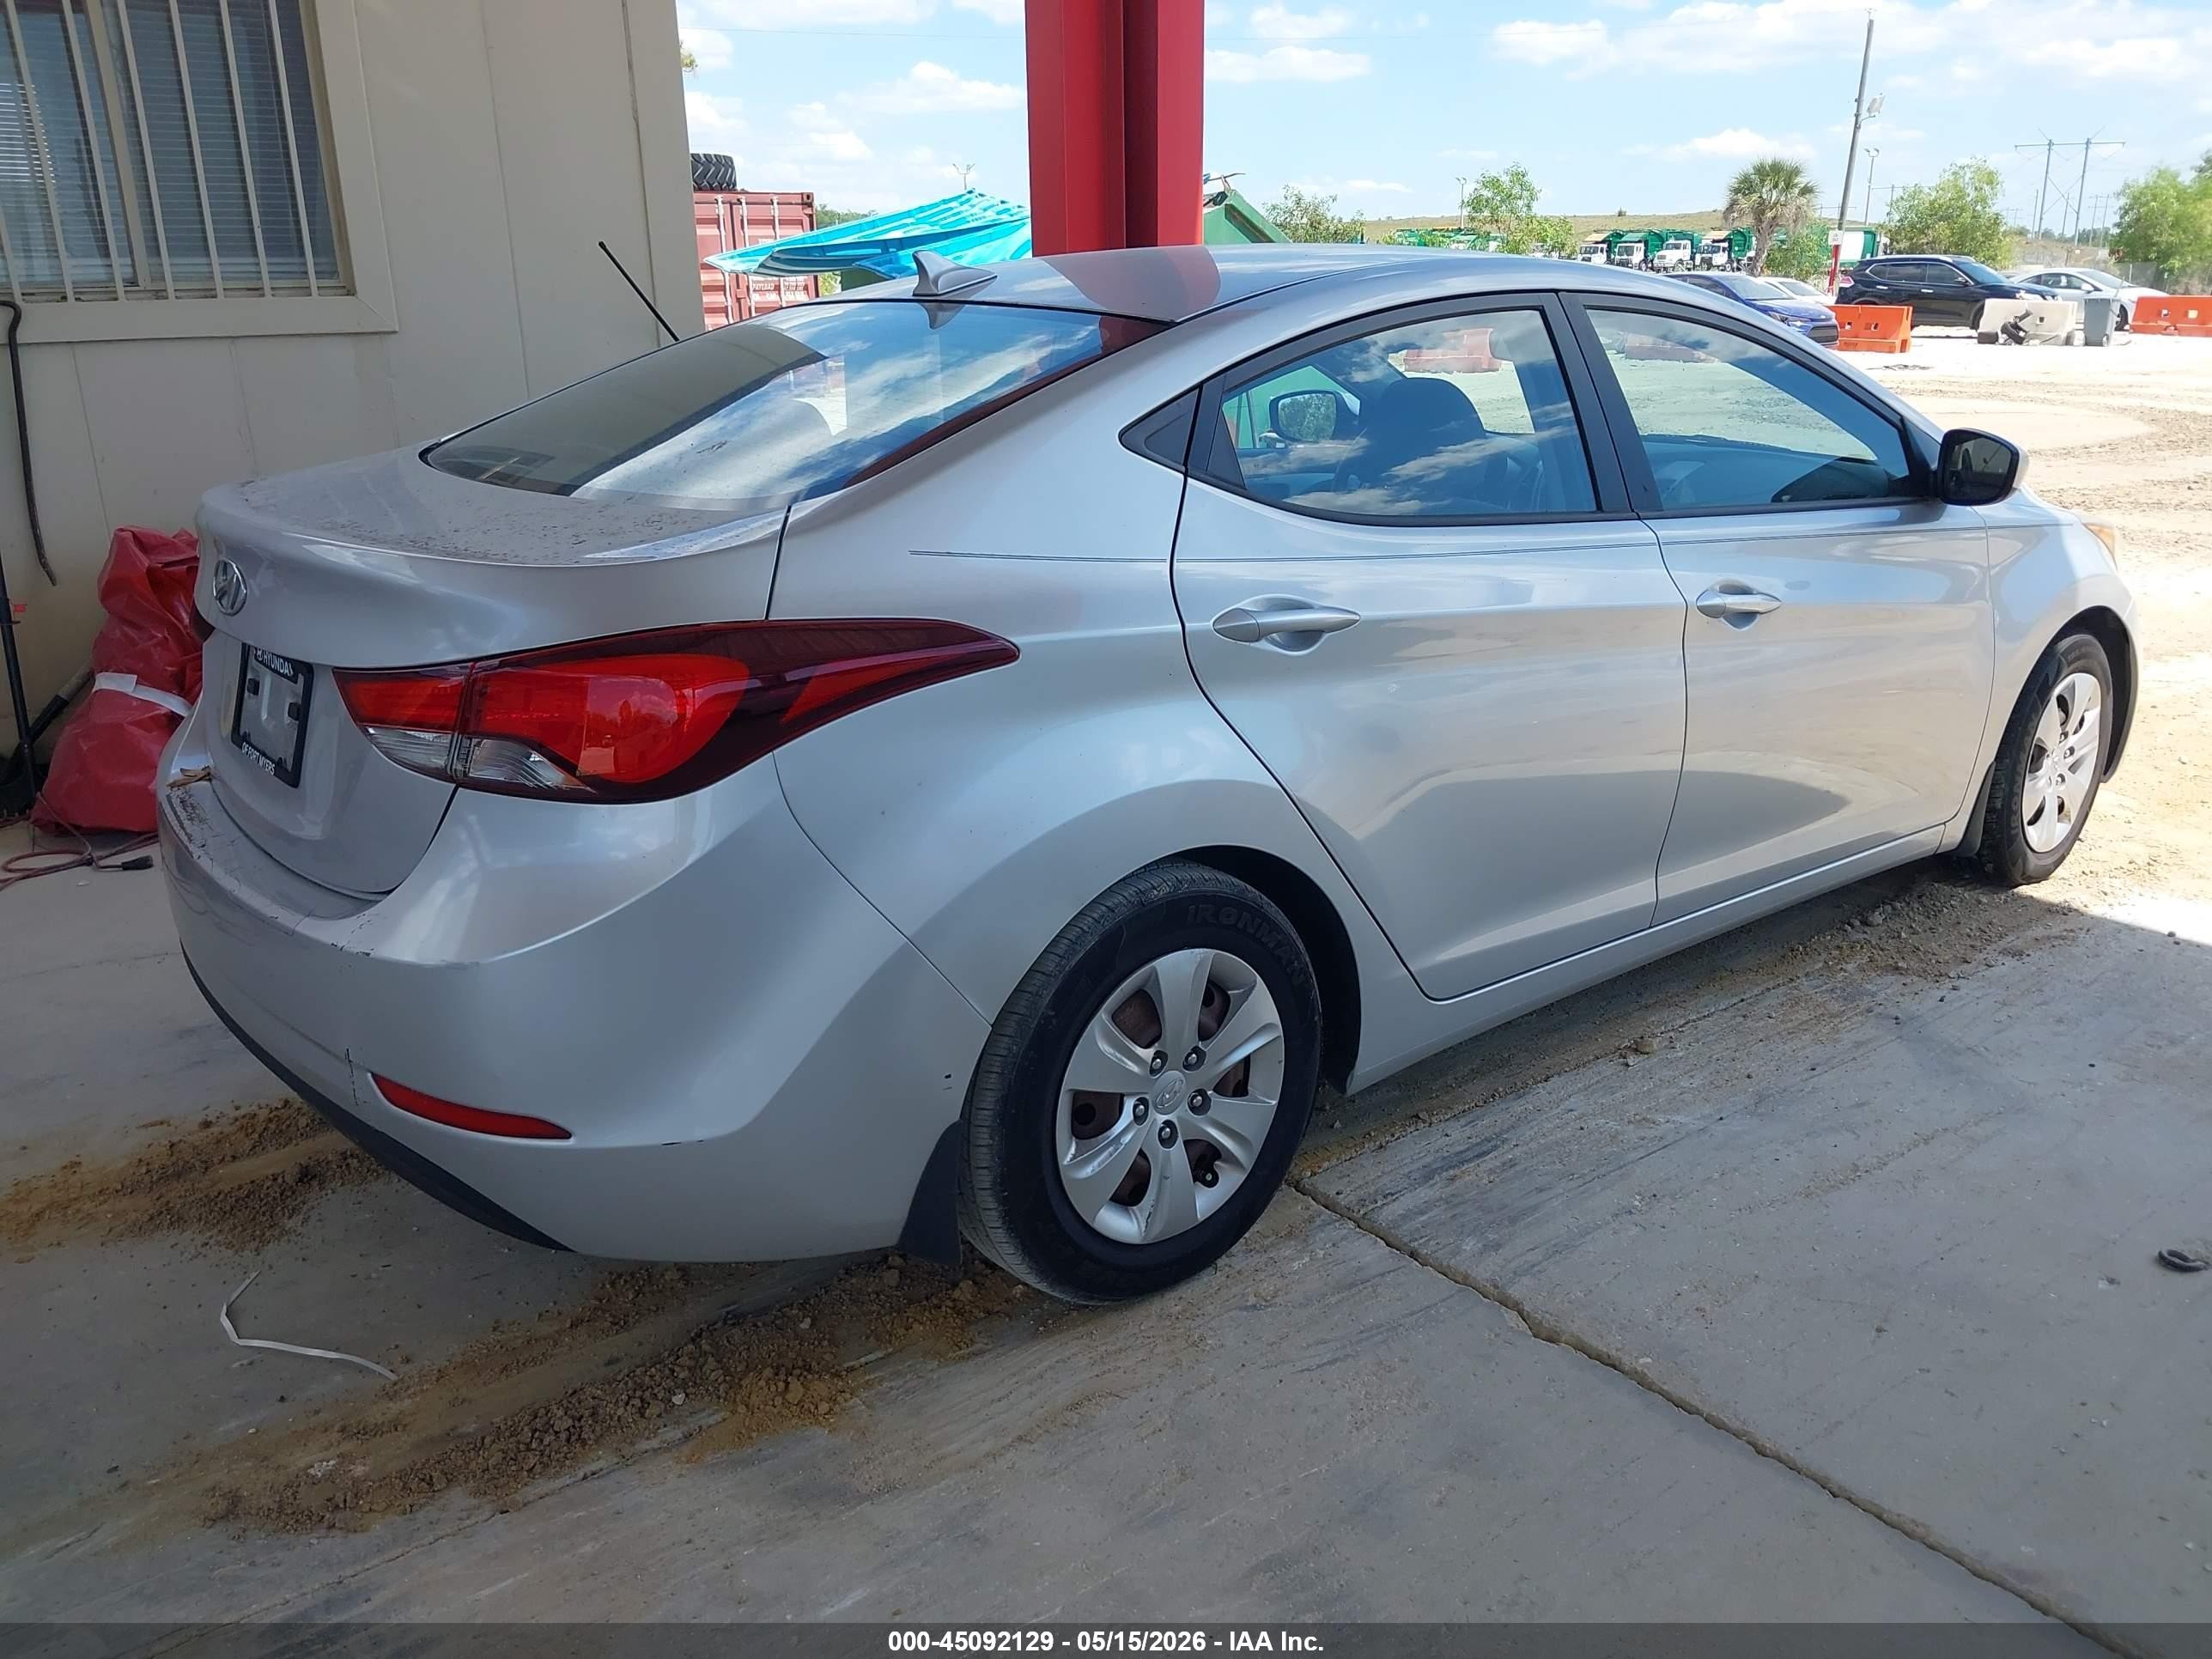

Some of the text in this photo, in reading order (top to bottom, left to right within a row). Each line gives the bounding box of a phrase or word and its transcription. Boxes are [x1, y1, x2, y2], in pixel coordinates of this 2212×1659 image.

[263, 651, 294, 677] HYUNDAI
[241, 741, 276, 775] OF FORT MYERS
